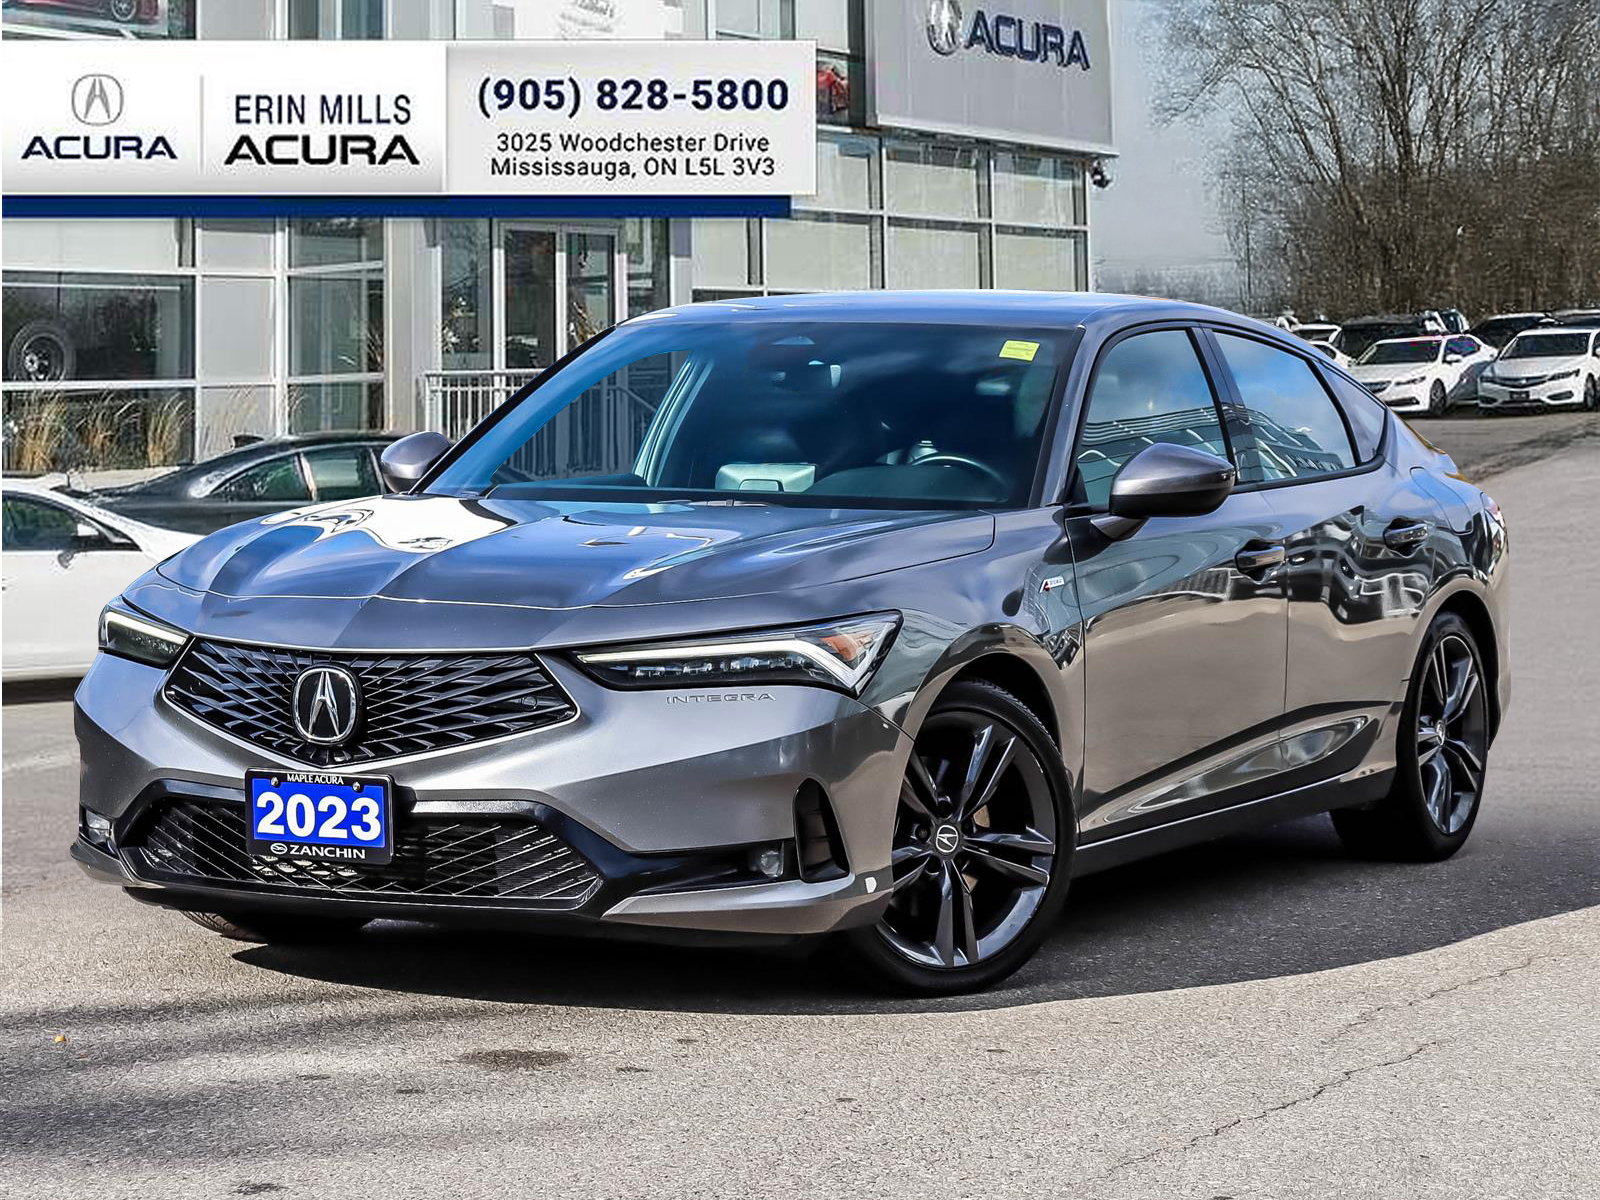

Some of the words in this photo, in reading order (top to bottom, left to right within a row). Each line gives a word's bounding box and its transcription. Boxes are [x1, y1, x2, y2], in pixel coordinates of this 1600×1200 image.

[964, 10, 1090, 71] ACURA
[666, 693, 776, 705] INTEGRA
[286, 773, 314, 784] MAPLE
[314, 775, 345, 786] ACURA
[256, 791, 382, 842] 2023
[289, 844, 366, 860] ZANCHIN
